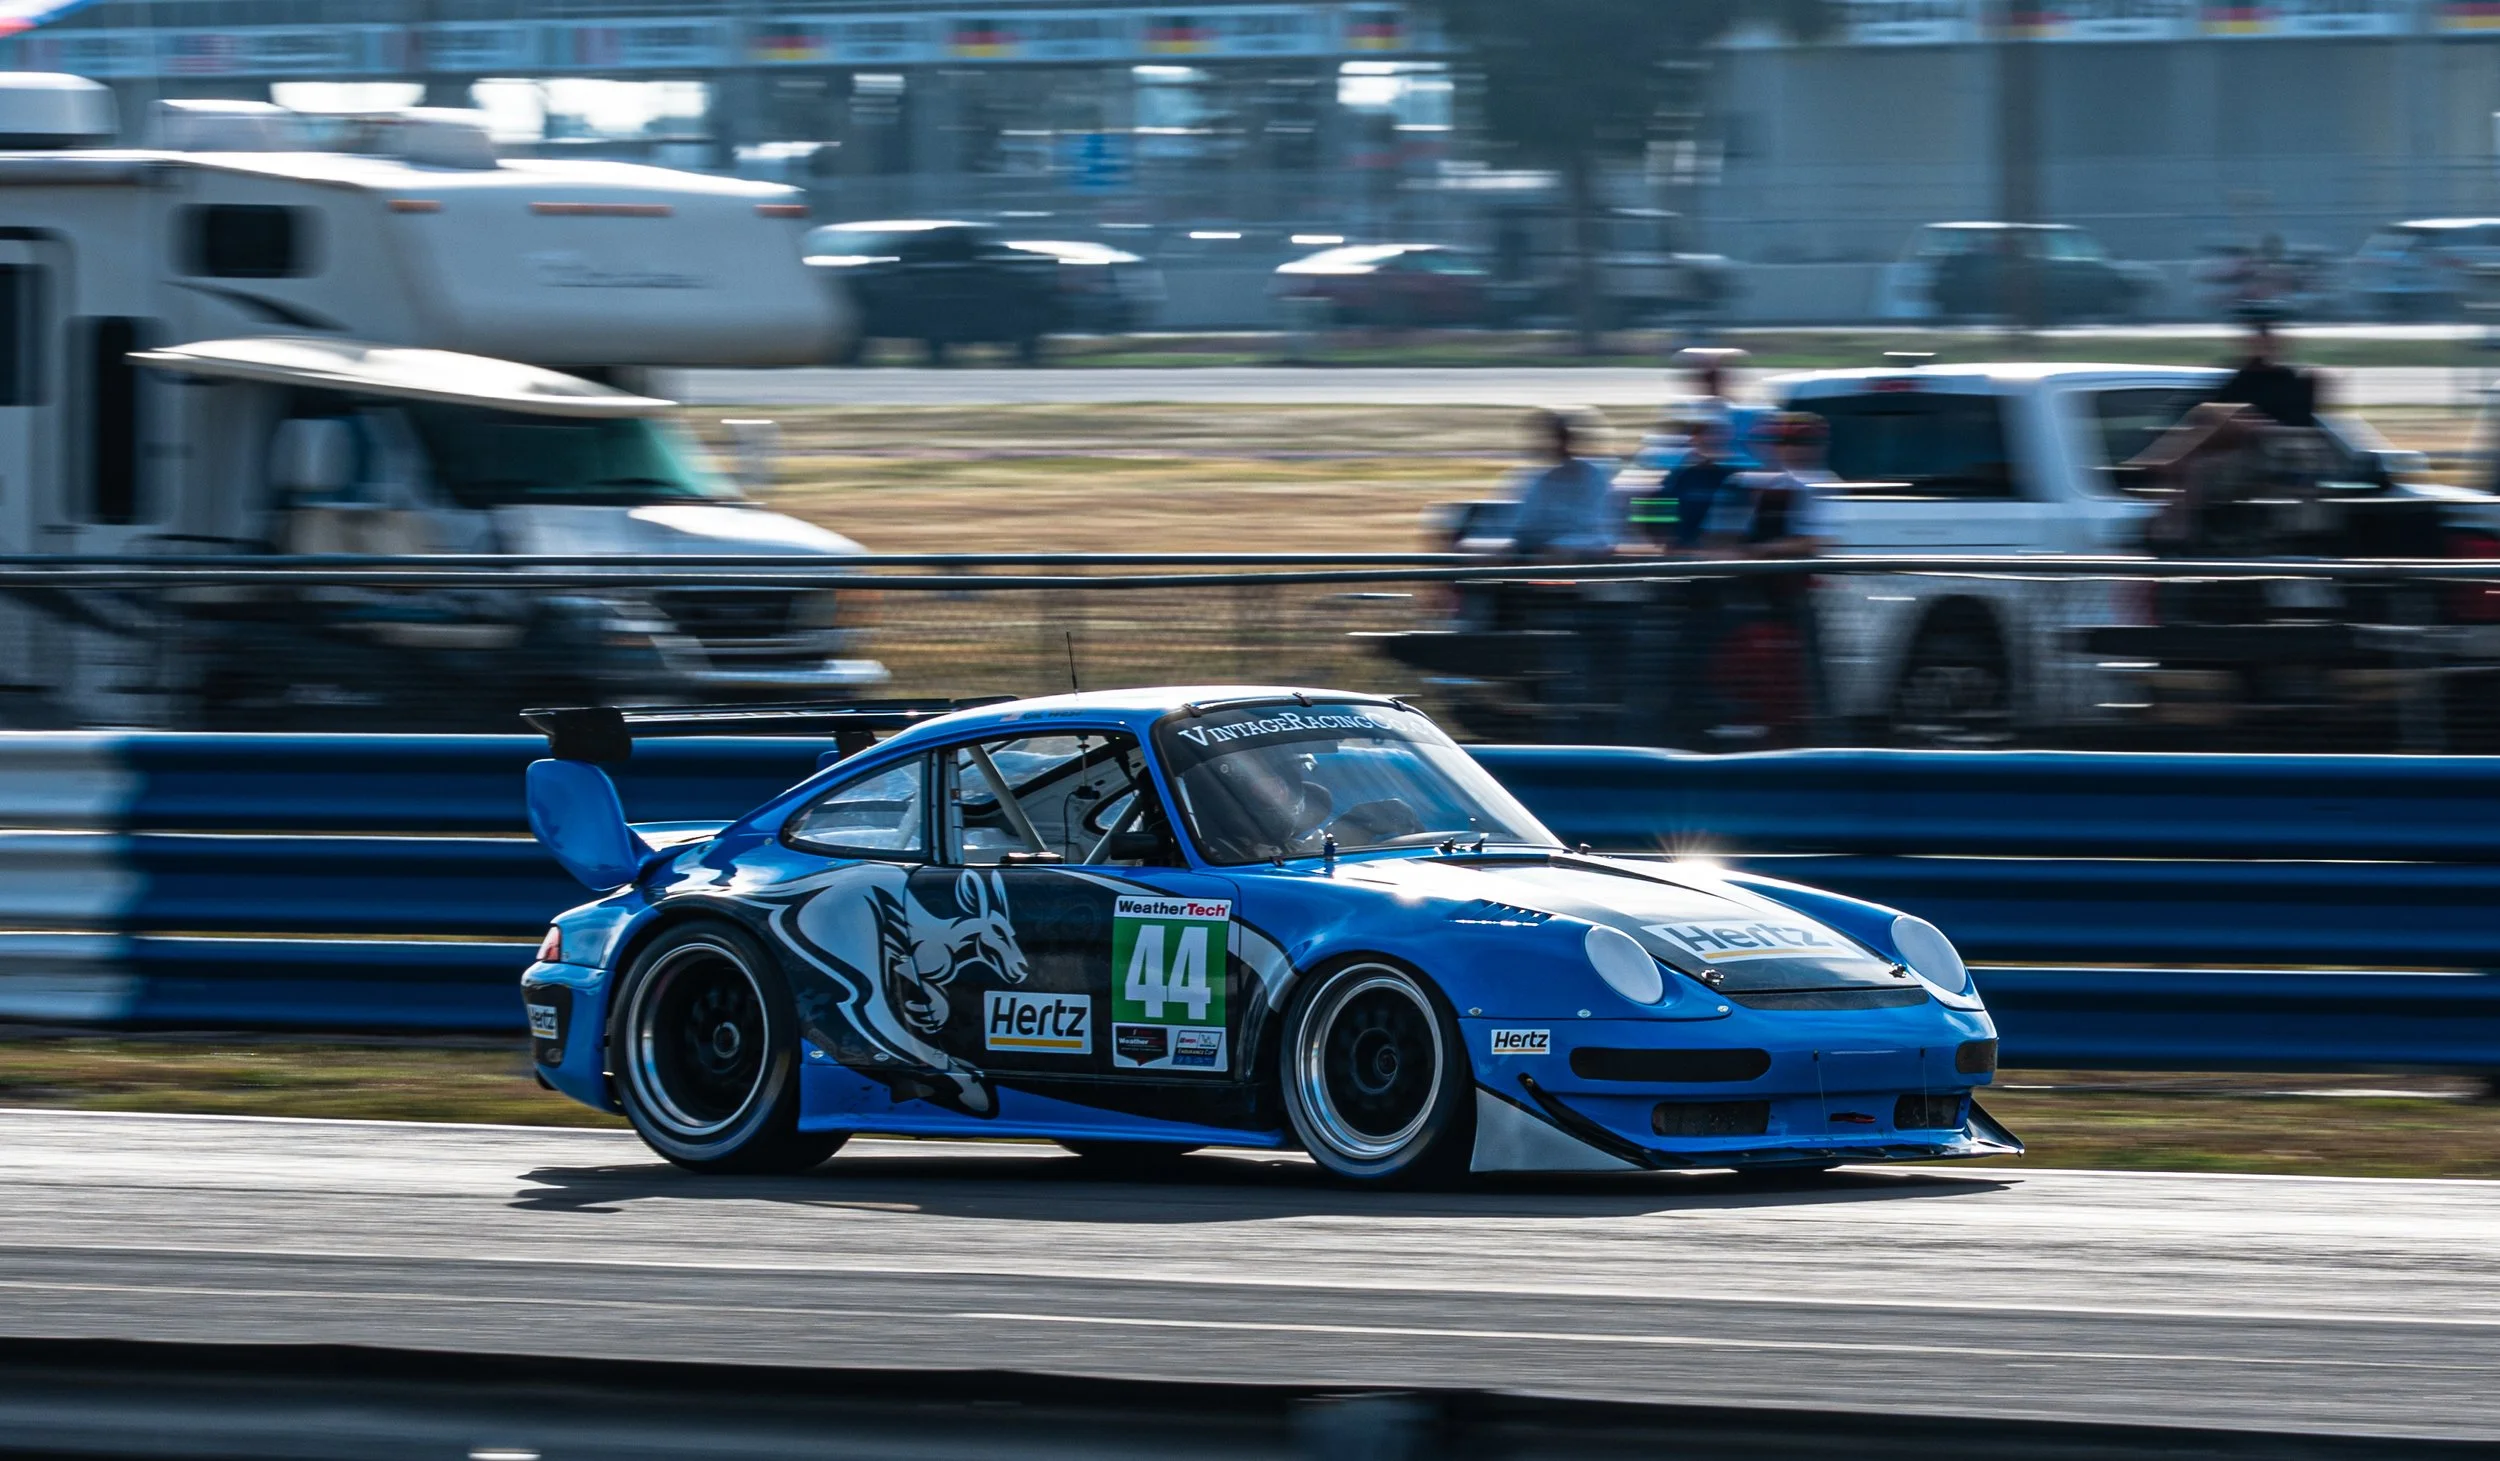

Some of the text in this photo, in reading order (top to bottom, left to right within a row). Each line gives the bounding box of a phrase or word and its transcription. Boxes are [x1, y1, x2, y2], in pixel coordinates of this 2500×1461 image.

[1119, 900, 1225, 917] WeatherTech
[1663, 922, 1832, 951] Hertz
[1125, 924, 1211, 1020] 44
[990, 997, 1087, 1036] Hertz
[1494, 1031, 1548, 1048] Hertz
